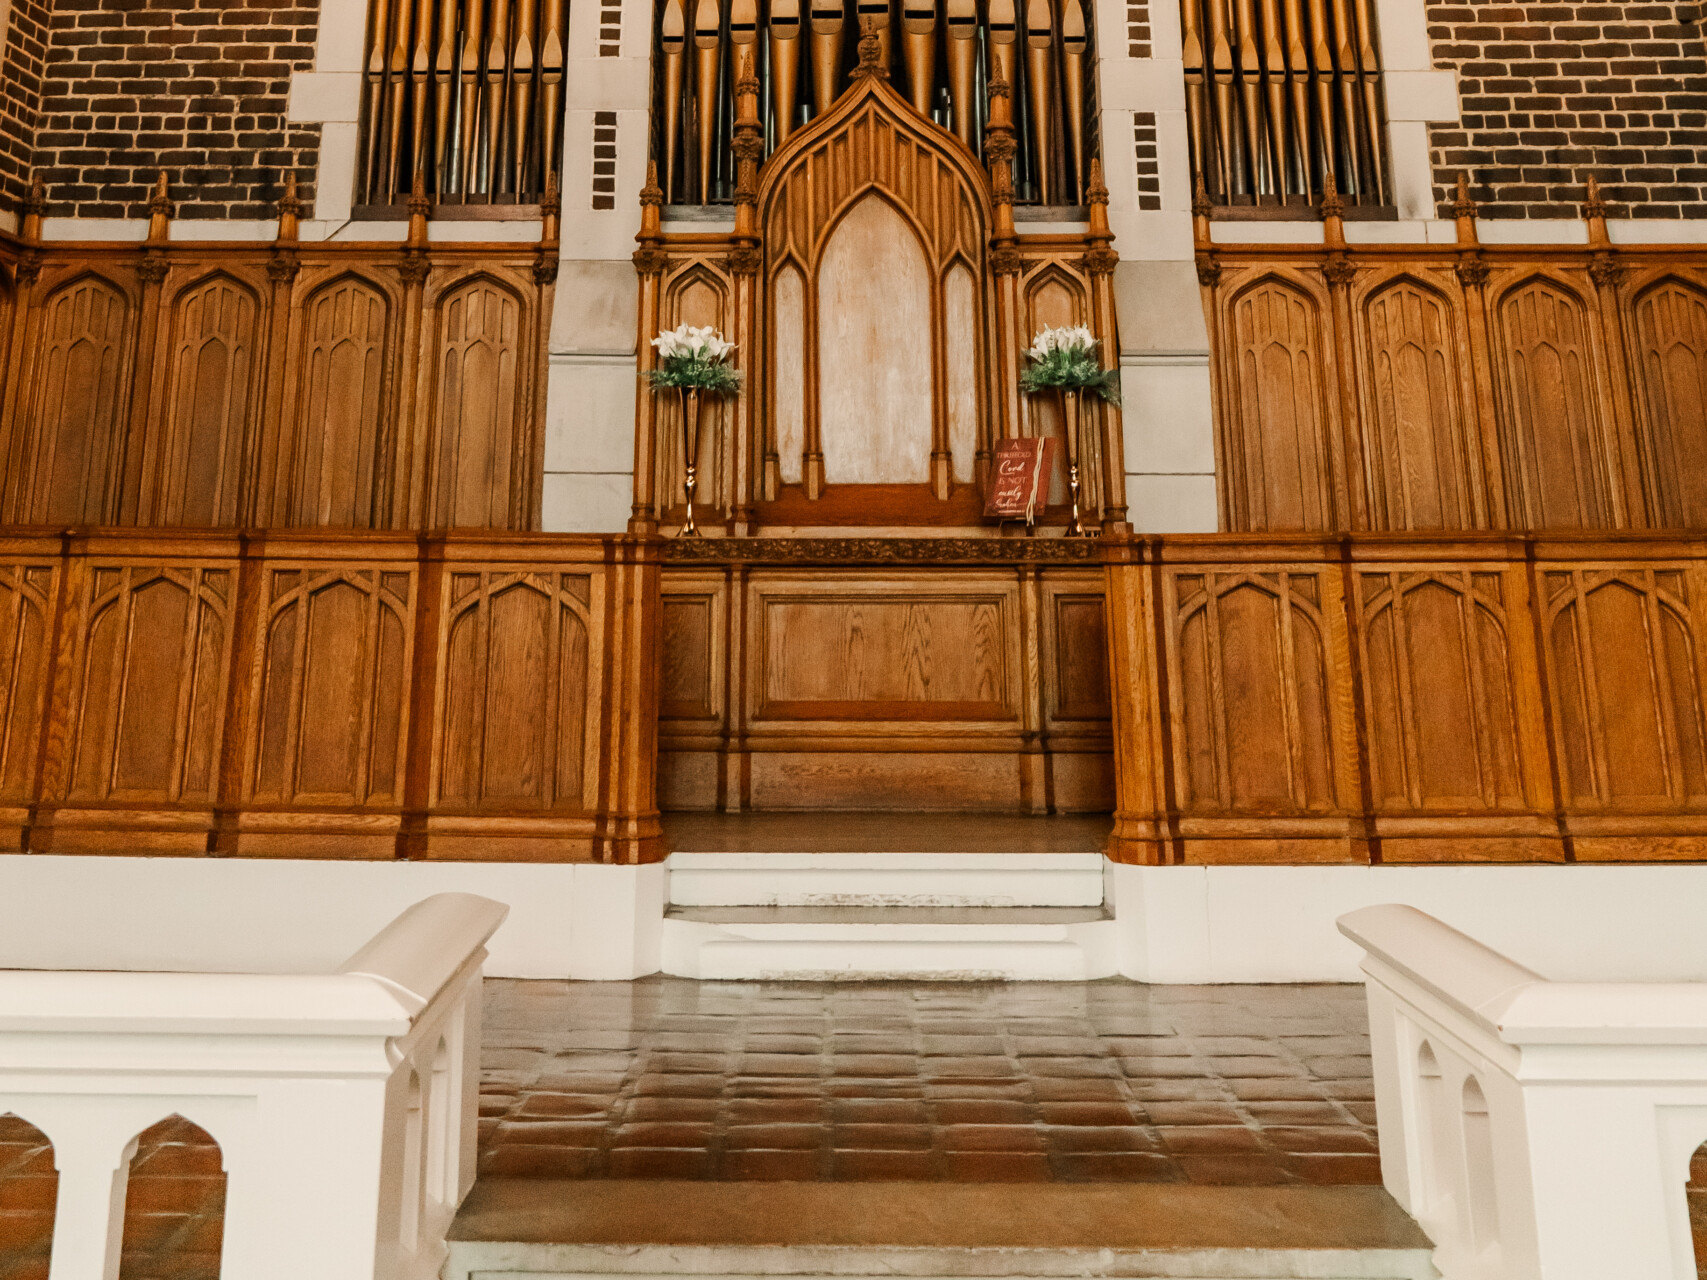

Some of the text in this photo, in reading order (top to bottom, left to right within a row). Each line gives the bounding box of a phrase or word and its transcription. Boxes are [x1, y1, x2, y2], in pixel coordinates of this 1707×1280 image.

[1011, 441, 1019, 450] A
[999, 459, 1025, 475] Cord
[1008, 476, 1027, 485] NOT
